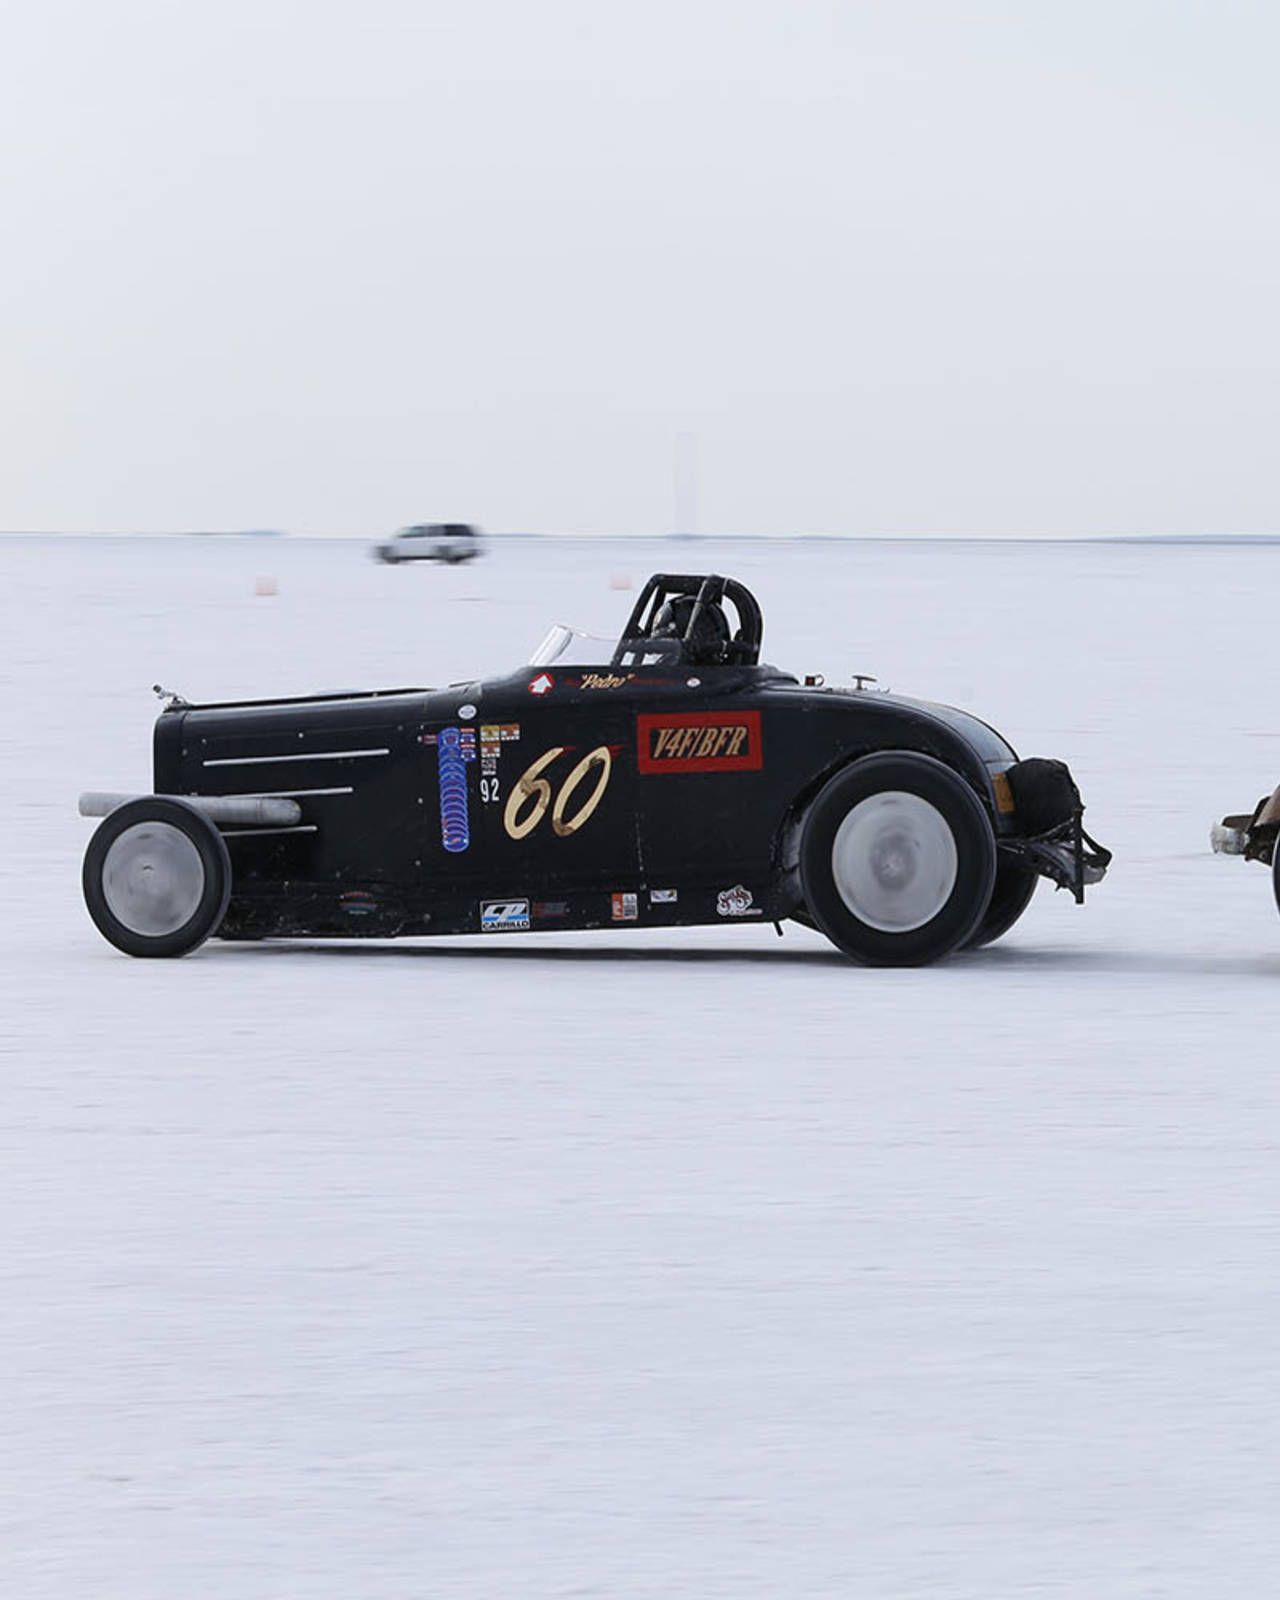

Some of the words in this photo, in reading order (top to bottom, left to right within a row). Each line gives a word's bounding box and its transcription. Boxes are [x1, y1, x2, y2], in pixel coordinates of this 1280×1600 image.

[653, 726, 748, 758] V4F/BFR
[480, 778, 500, 803] 92
[503, 745, 611, 840] 60
